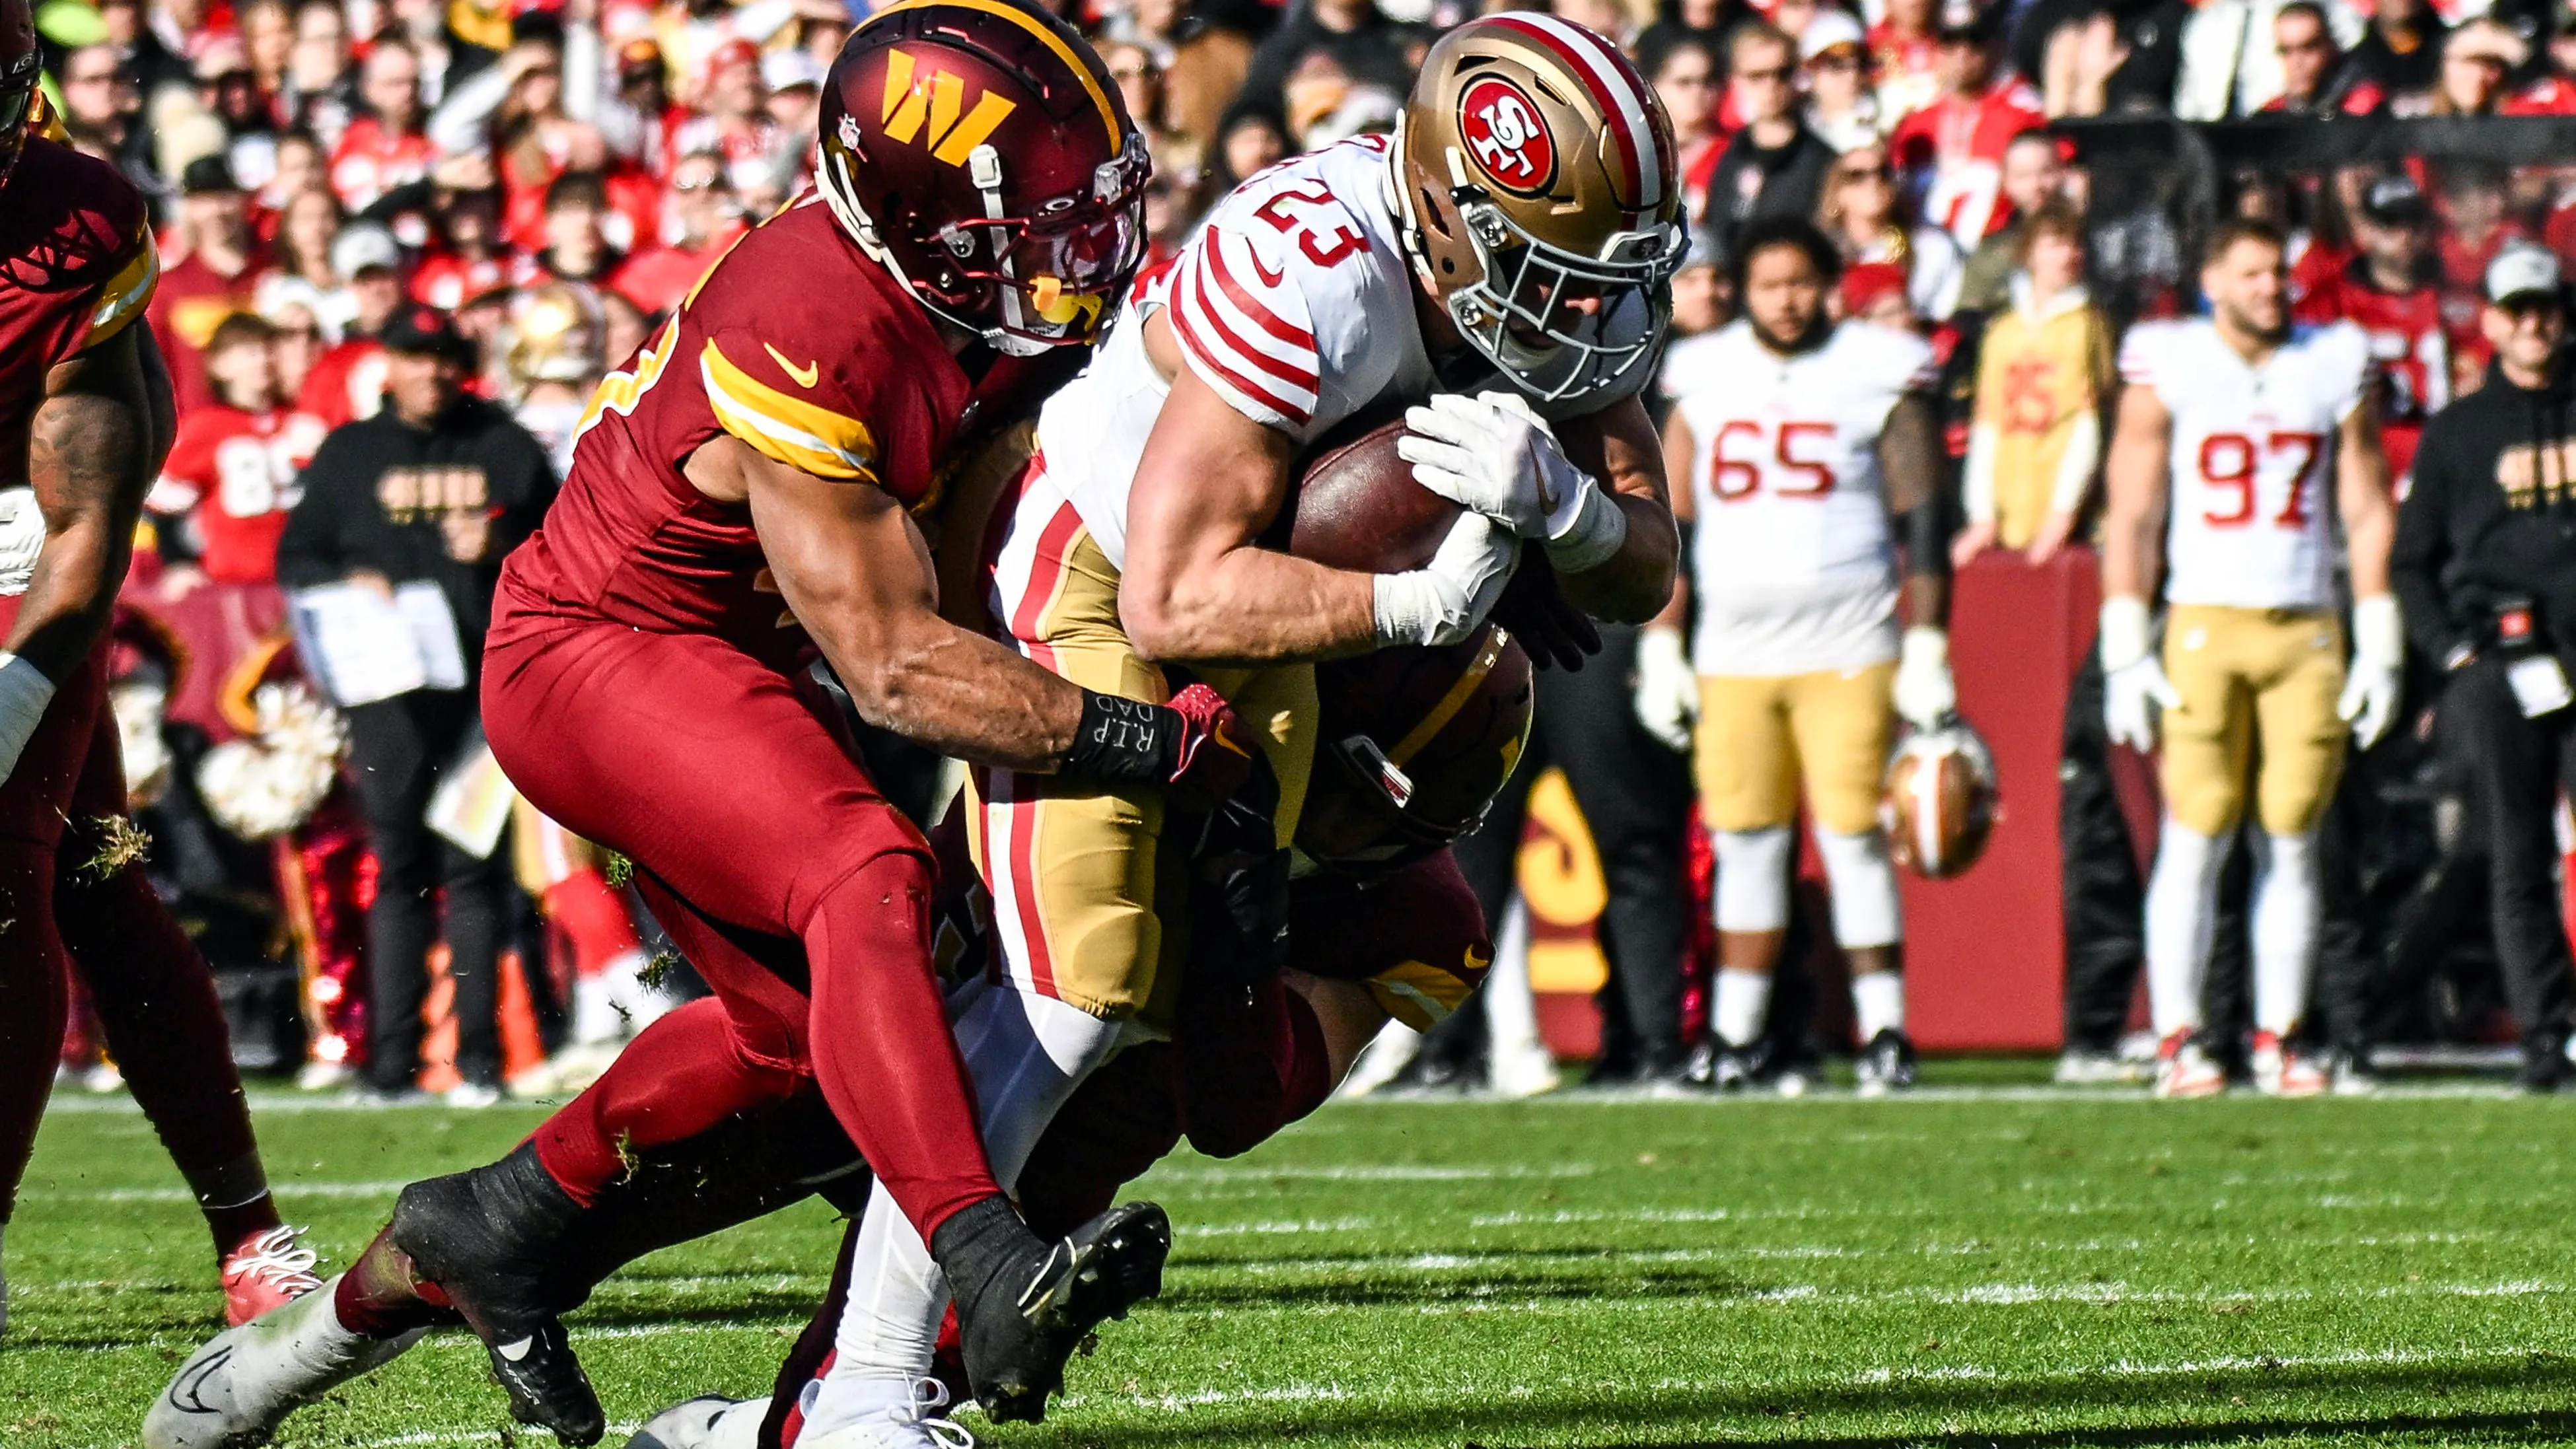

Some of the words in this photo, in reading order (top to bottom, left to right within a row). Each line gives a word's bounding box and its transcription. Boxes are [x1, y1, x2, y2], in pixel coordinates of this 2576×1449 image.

[1252, 177, 1372, 268] 23
[1710, 419, 1838, 505] 65
[2197, 433, 2323, 528] 97
[1096, 695, 1154, 723] DAD
